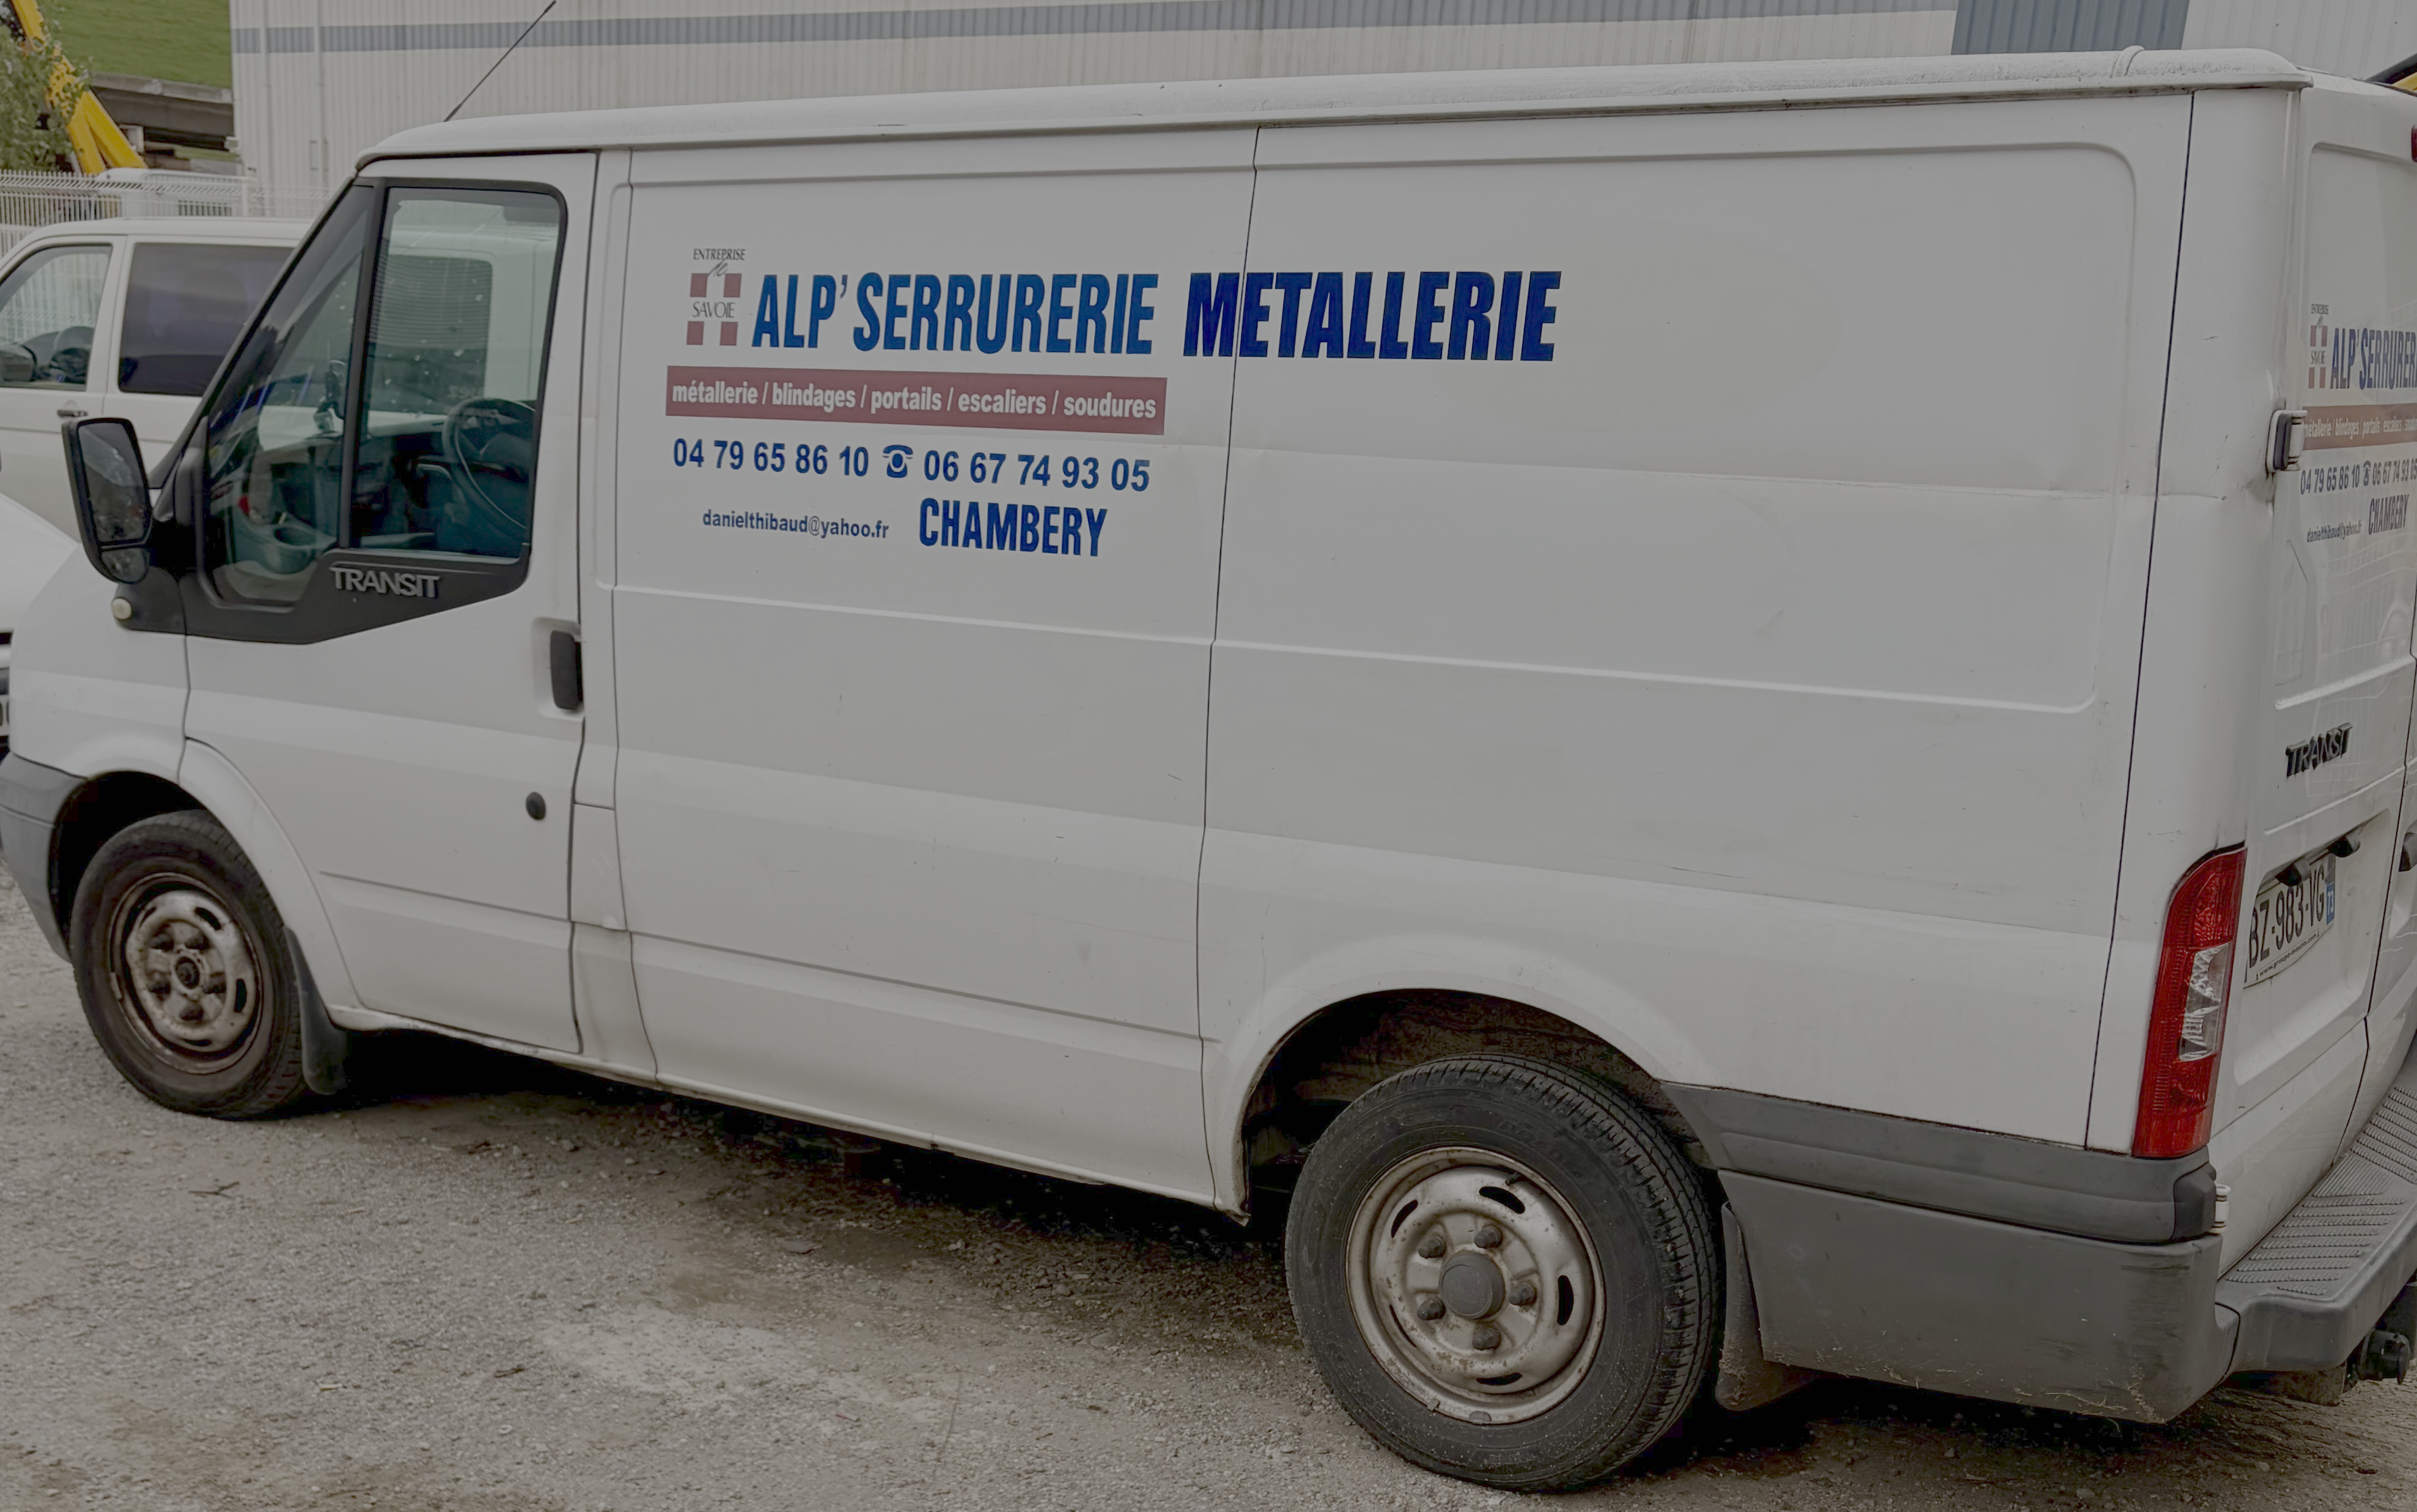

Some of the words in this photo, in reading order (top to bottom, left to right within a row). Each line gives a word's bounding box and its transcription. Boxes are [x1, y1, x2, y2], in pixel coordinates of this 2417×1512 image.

[693, 248, 746, 260] ENTREPRISE
[692, 301, 735, 318] SAVOIE
[1183, 271, 1562, 361] METALLERIE
[673, 380, 757, 405] métallerie
[772, 383, 856, 413] blindages
[871, 387, 942, 414] portails
[958, 389, 1046, 414] escaliers
[1064, 392, 1157, 418] soudures
[674, 438, 704, 468] 04
[713, 440, 744, 470] 79
[754, 442, 785, 472] 65
[795, 444, 828, 474] 86
[839, 446, 869, 477] 10
[924, 450, 959, 482] 06
[970, 452, 1006, 484] 67
[1018, 454, 1051, 486] 74
[1062, 456, 1099, 490] 93
[1111, 458, 1150, 492] 05
[2301, 470, 2311, 495] 04
[2314, 468, 2324, 493] 79
[2327, 467, 2337, 491] 65
[2339, 465, 2349, 490] 86
[2352, 464, 2360, 488] 10
[2372, 462, 2382, 485] 06
[2383, 461, 2391, 484] 67
[2393, 460, 2400, 483] 74
[702, 508, 889, 538] danielthibaud@yahoo.fr
[919, 497, 1107, 557] CHAMBERY
[2368, 494, 2409, 535] CHAMBERY
[329, 566, 440, 598] TRANSIT
[2286, 722, 2353, 778] TRANSIT
[2327, 889, 2334, 916] 73
